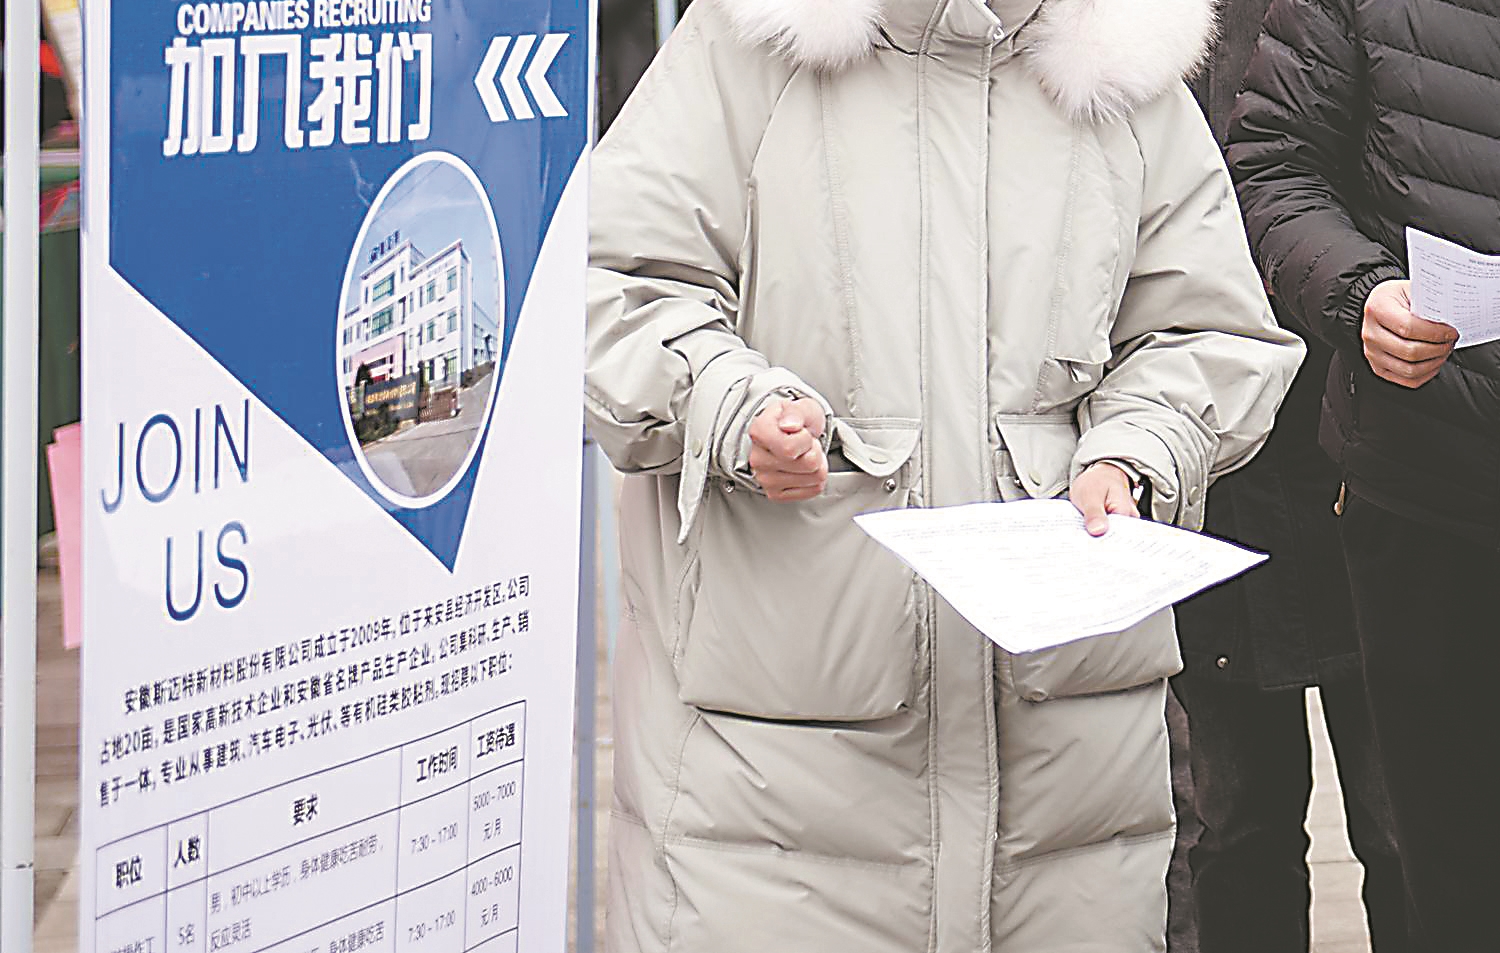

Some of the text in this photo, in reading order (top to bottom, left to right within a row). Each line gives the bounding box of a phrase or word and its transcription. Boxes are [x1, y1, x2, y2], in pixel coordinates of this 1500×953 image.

[101, 398, 251, 514] JOIN
[165, 521, 249, 621] US
[476, 722, 516, 758] 工资待遇
[416, 745, 458, 783] 工作时间
[292, 795, 319, 826] 要求
[174, 835, 201, 868] 人数
[115, 853, 143, 888] 职位
